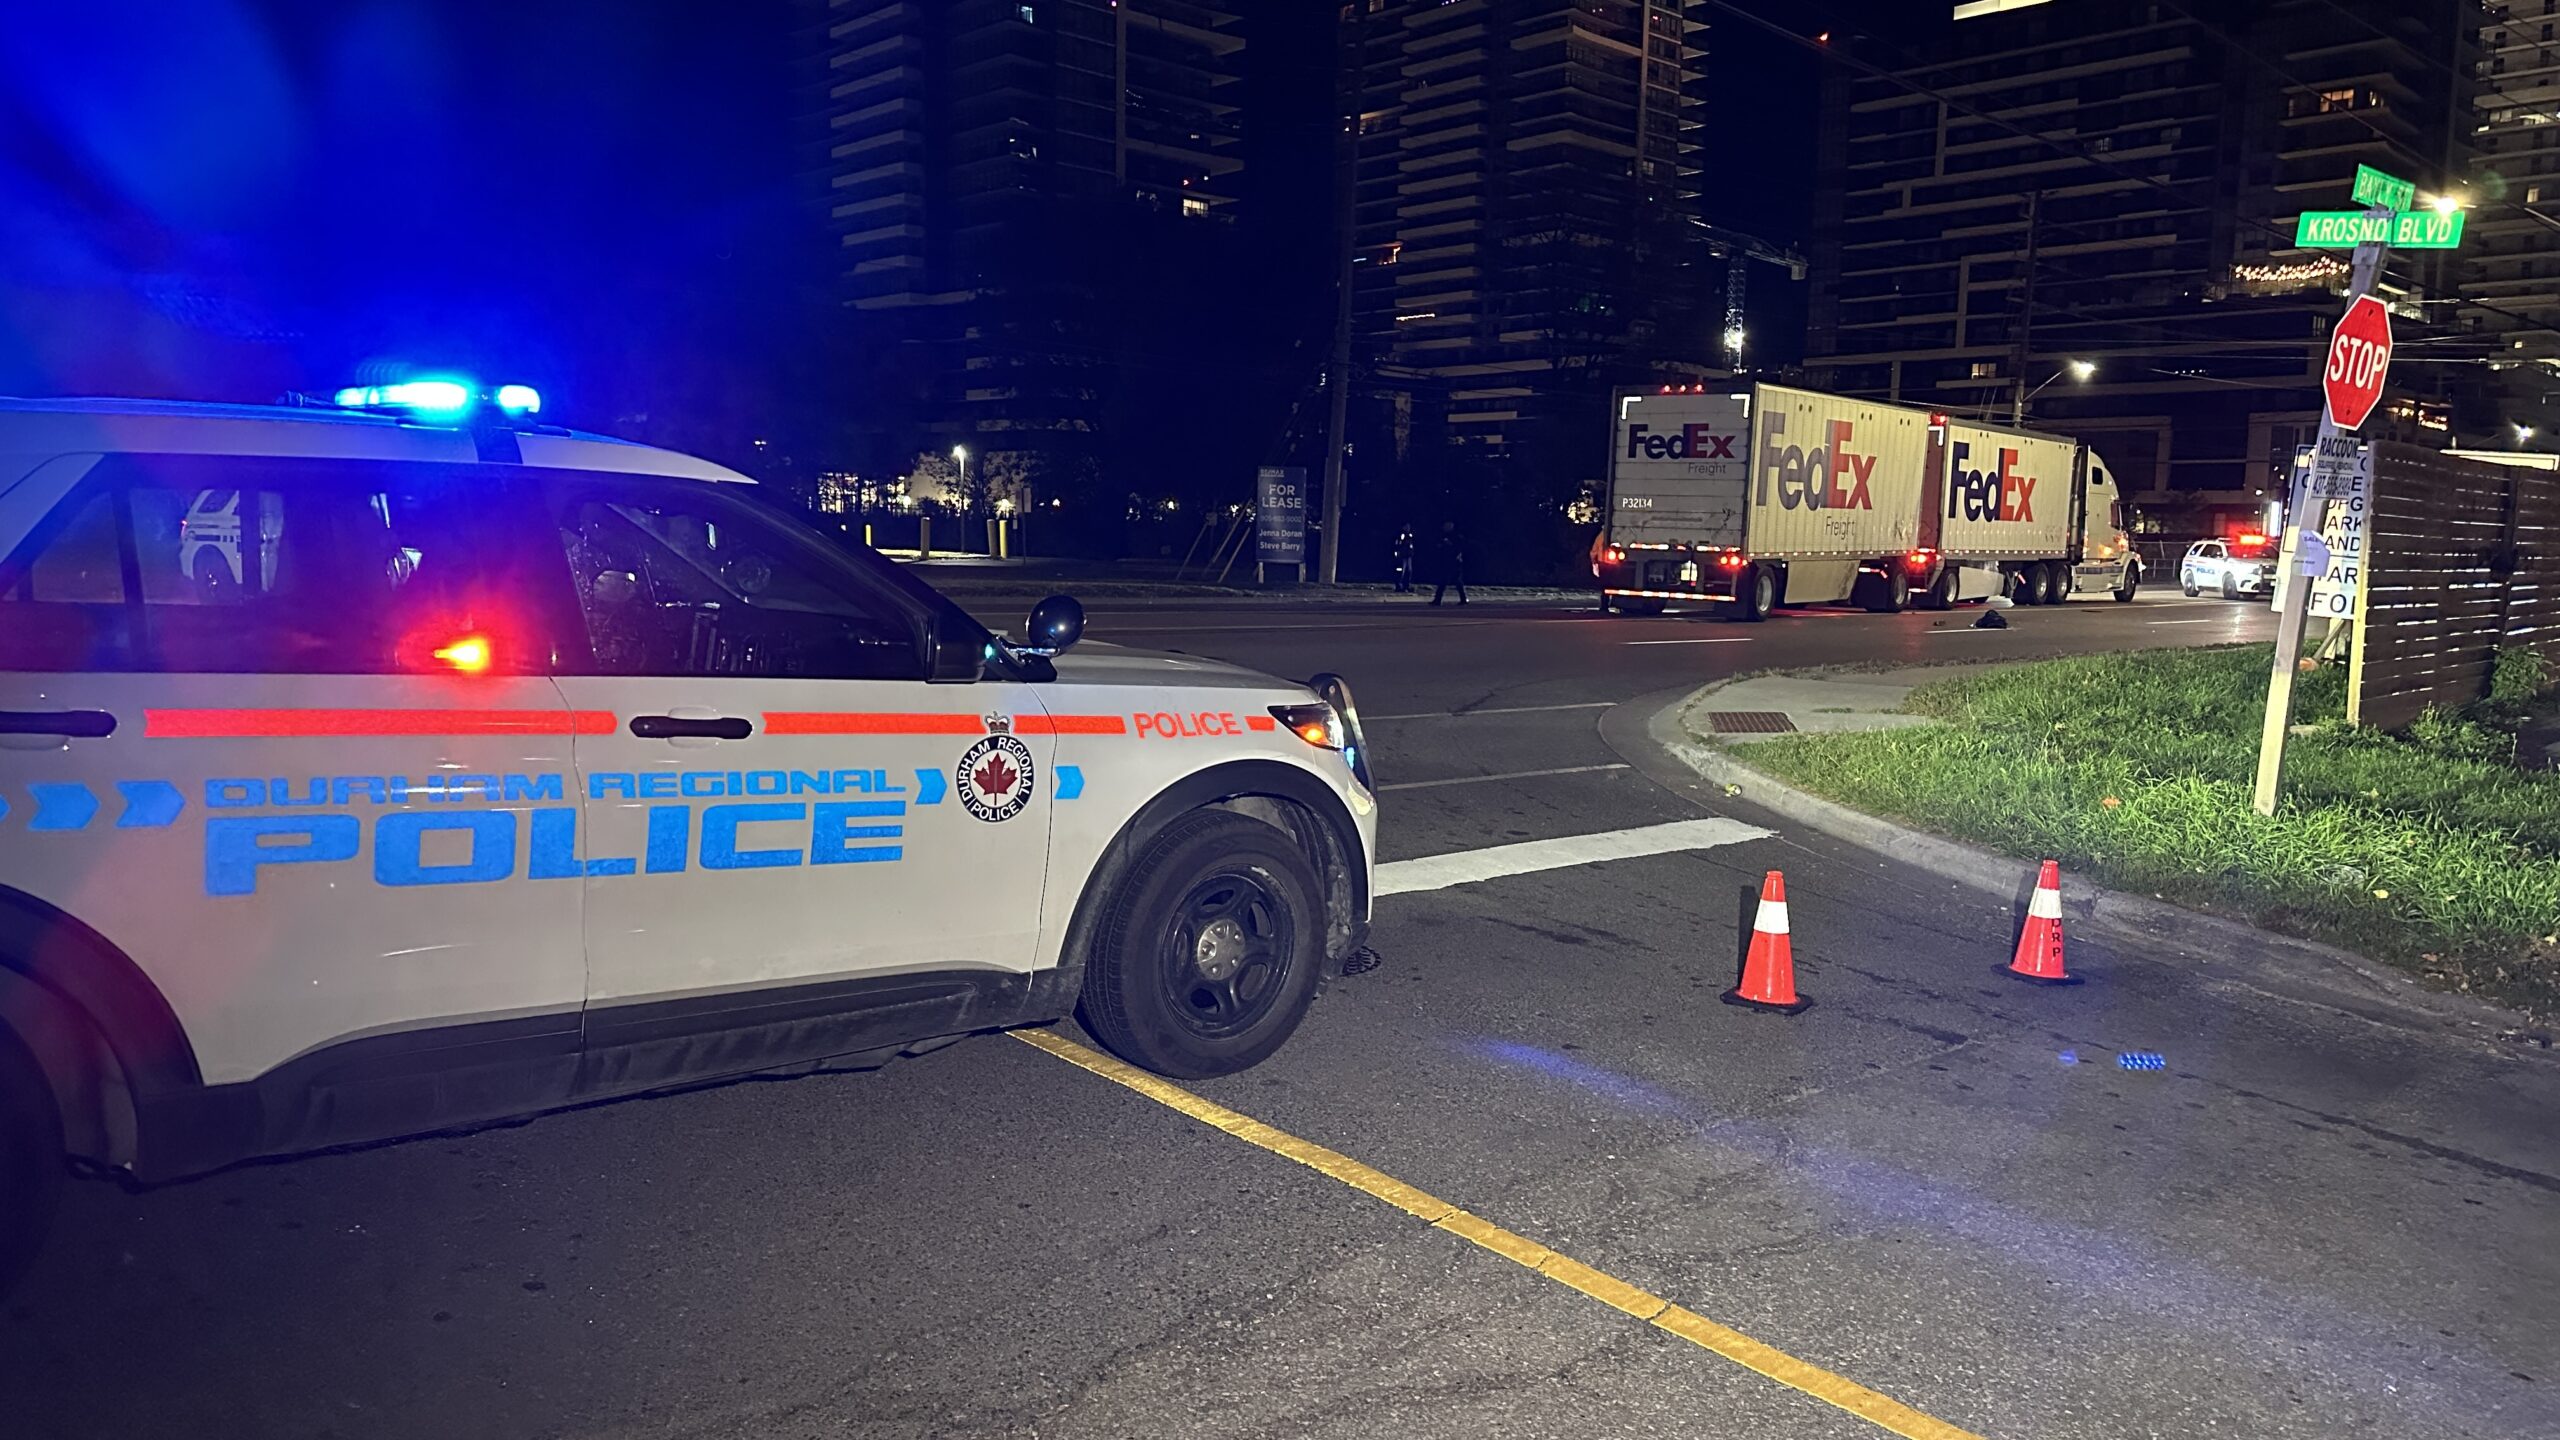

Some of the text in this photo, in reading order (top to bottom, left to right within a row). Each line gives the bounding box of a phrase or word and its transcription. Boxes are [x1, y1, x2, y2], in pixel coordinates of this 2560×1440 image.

[2306, 217, 2453, 243] KROSNO BLVD
[2330, 334, 2387, 390] STOP
[1627, 423, 1736, 459] FedEx
[2320, 437, 2359, 458] RACCOON
[1688, 463, 1726, 476] Freight
[1756, 410, 1877, 511] FedEx
[1269, 484, 1295, 495] FOR
[1948, 441, 2036, 522] FedEx
[1262, 497, 1301, 508] LEASE
[1259, 529, 1279, 537] Jenna
[1825, 516, 1855, 540] Freight
[1281, 543, 1300, 551] Barry
[1133, 711, 1242, 738] POLICE
[959, 737, 1033, 802] DURHAM REGIONAL
[205, 769, 906, 808] DURHAM REGIONAL
[970, 801, 1020, 821] POLICE
[205, 800, 907, 896] POLICE
